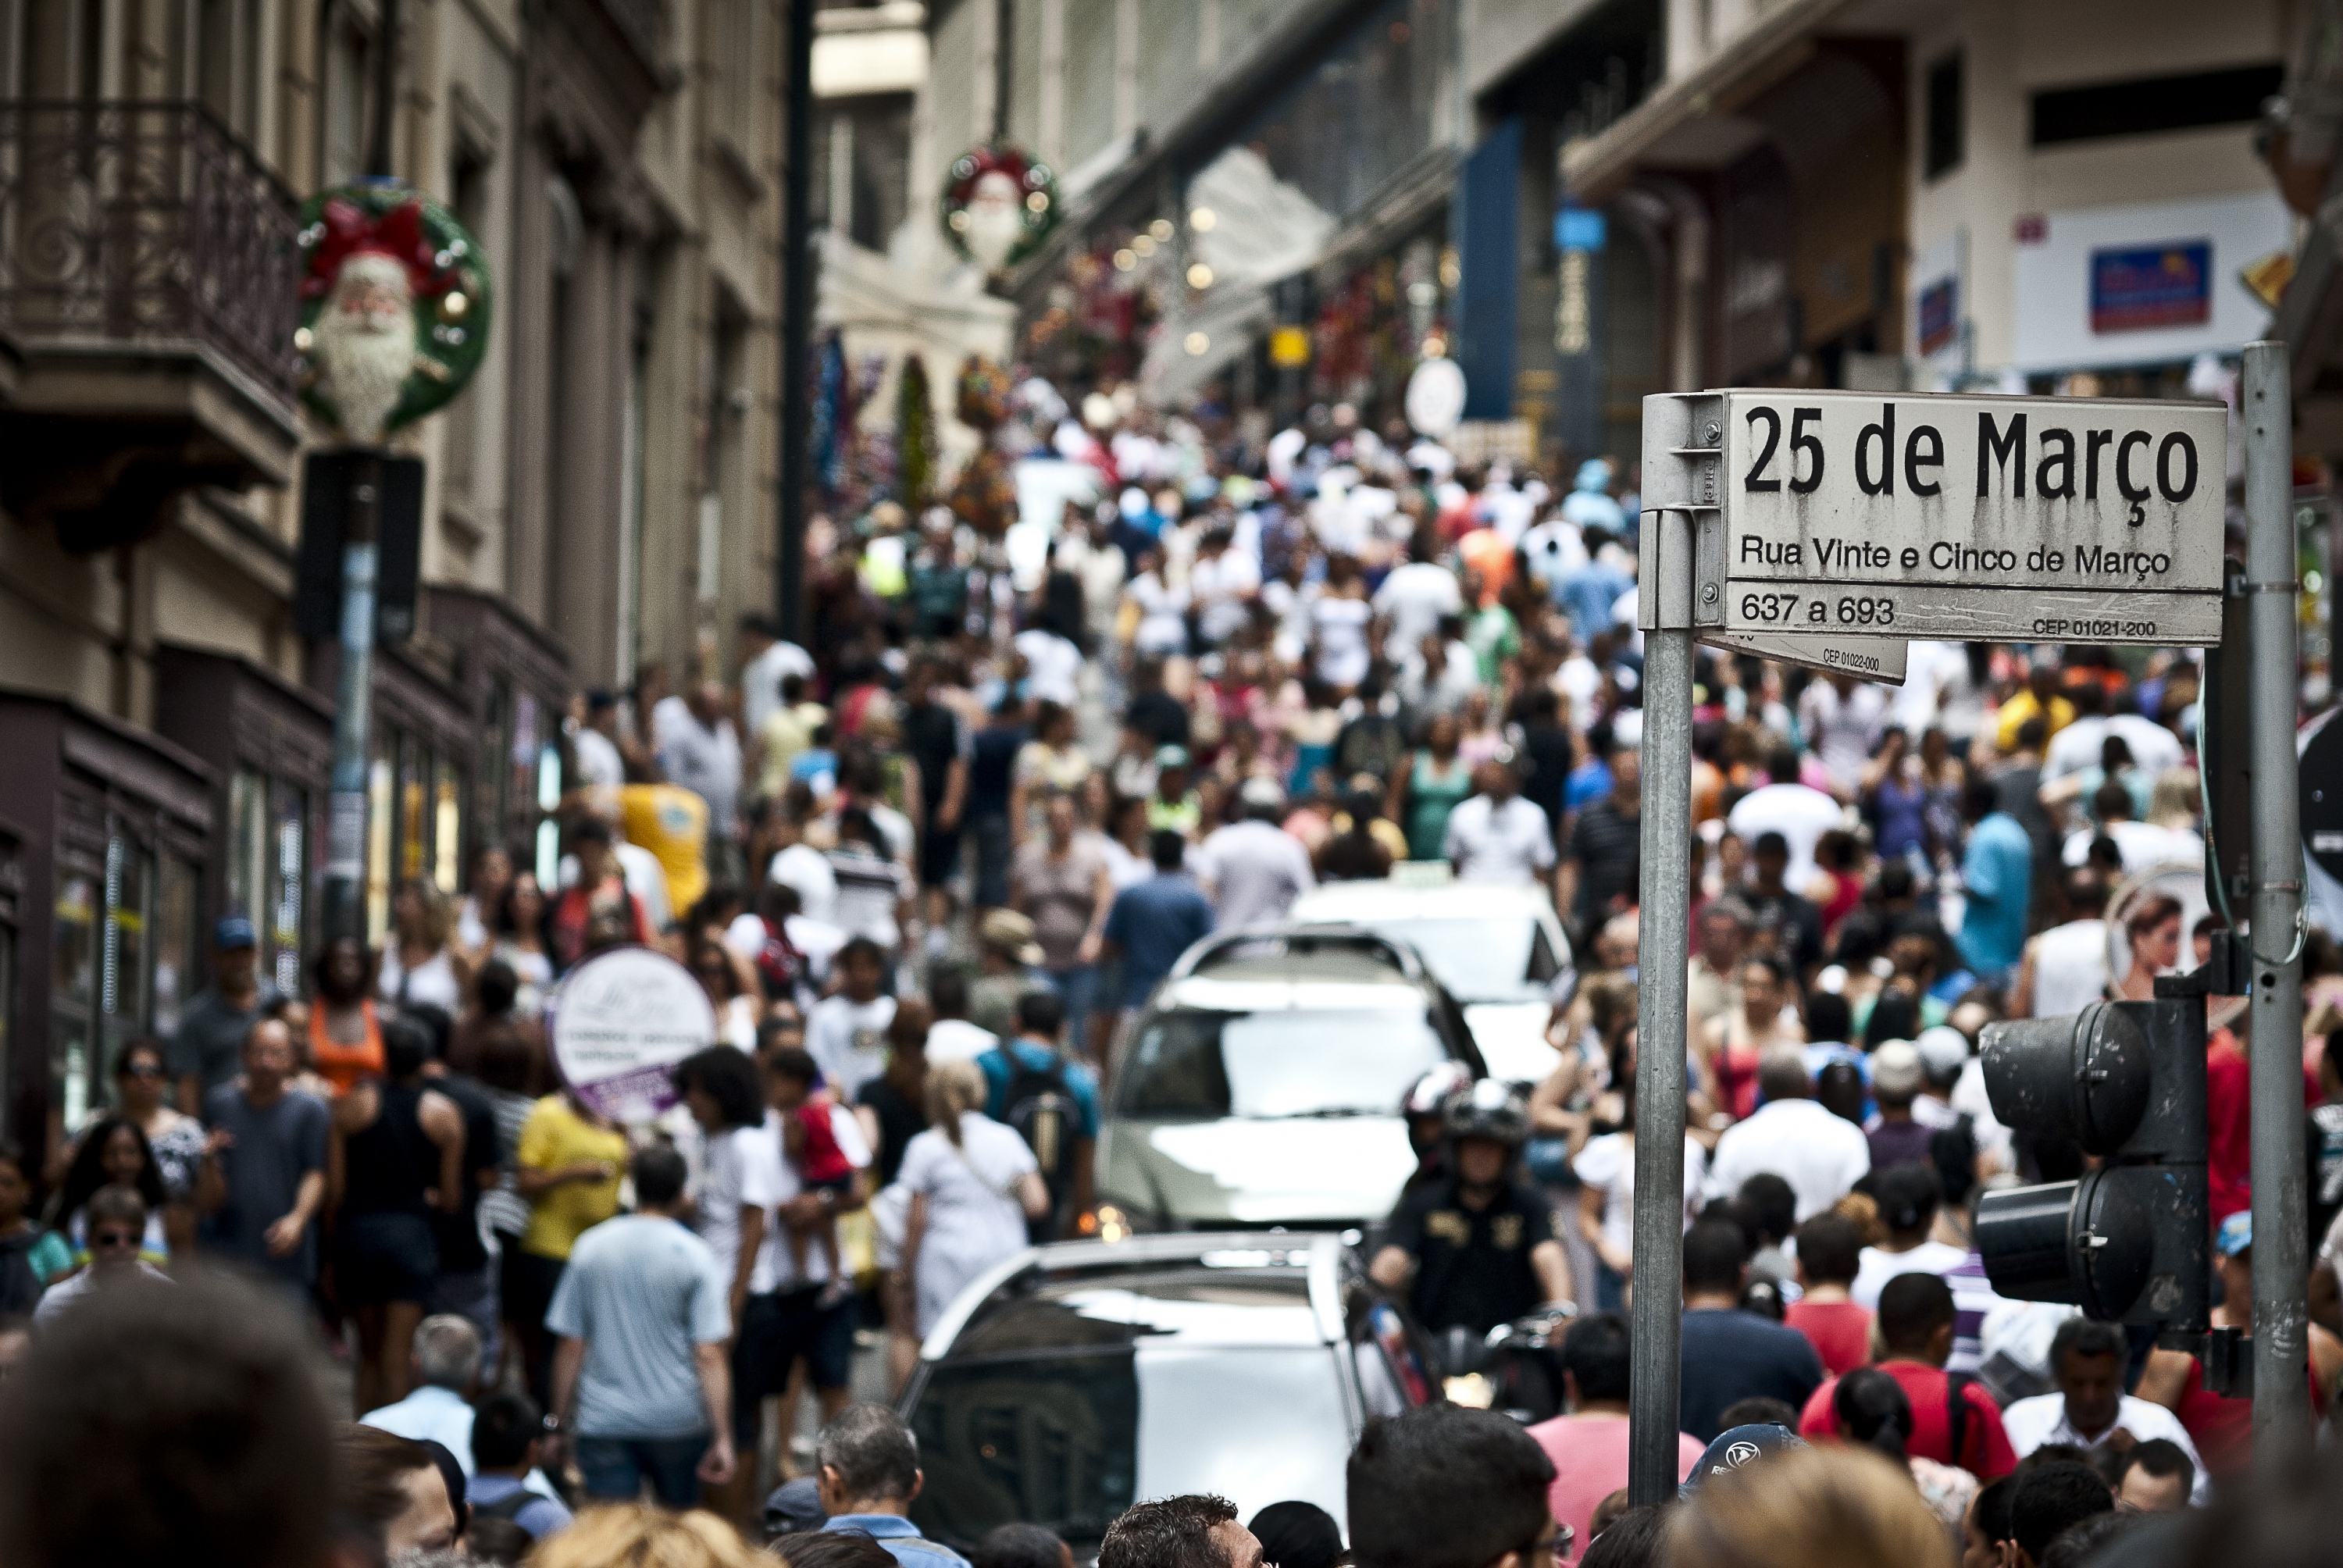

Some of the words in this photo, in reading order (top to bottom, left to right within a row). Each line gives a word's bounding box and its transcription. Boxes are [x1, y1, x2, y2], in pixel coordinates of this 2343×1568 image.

[1744, 406, 1824, 495] 25
[1855, 402, 1945, 497] de
[1976, 412, 2199, 529] Março
[1741, 533, 1803, 566] Rua
[1812, 537, 1891, 568] Vinte
[1900, 547, 1920, 571] e
[1928, 541, 2017, 572] Cinco
[2026, 543, 2065, 572] de
[2075, 544, 2171, 580] Março
[1742, 593, 1799, 622] 637
[1808, 600, 1828, 623] a
[1837, 596, 1895, 625] 693
[2032, 618, 2070, 636] CEP
[2072, 620, 2156, 636] 01021-200
[1823, 648, 1840, 665] CEP
[1841, 651, 1880, 672] 01022-000
